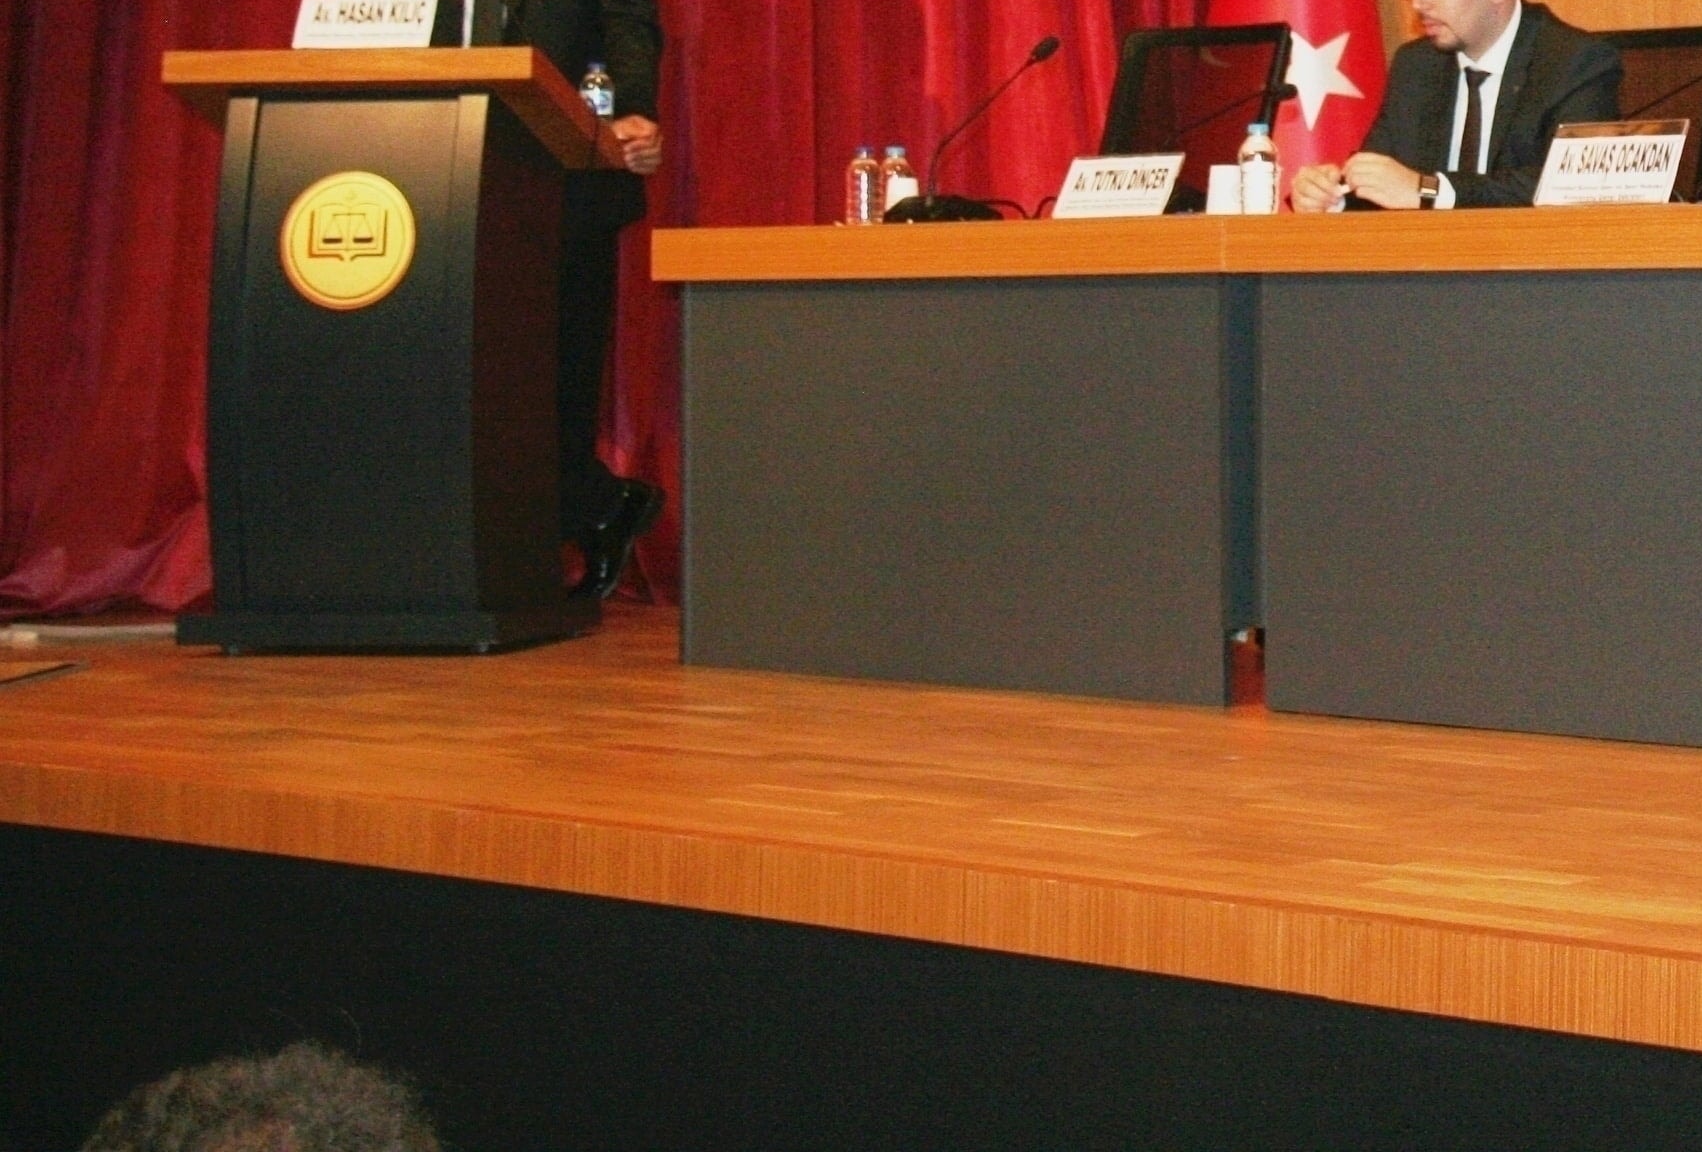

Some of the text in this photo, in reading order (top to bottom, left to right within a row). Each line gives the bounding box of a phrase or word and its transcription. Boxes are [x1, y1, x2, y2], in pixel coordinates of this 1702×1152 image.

[336, 0, 384, 24] HASAN
[1615, 141, 1674, 174] OCAKDAN
[1091, 169, 1130, 192] TUTKU
